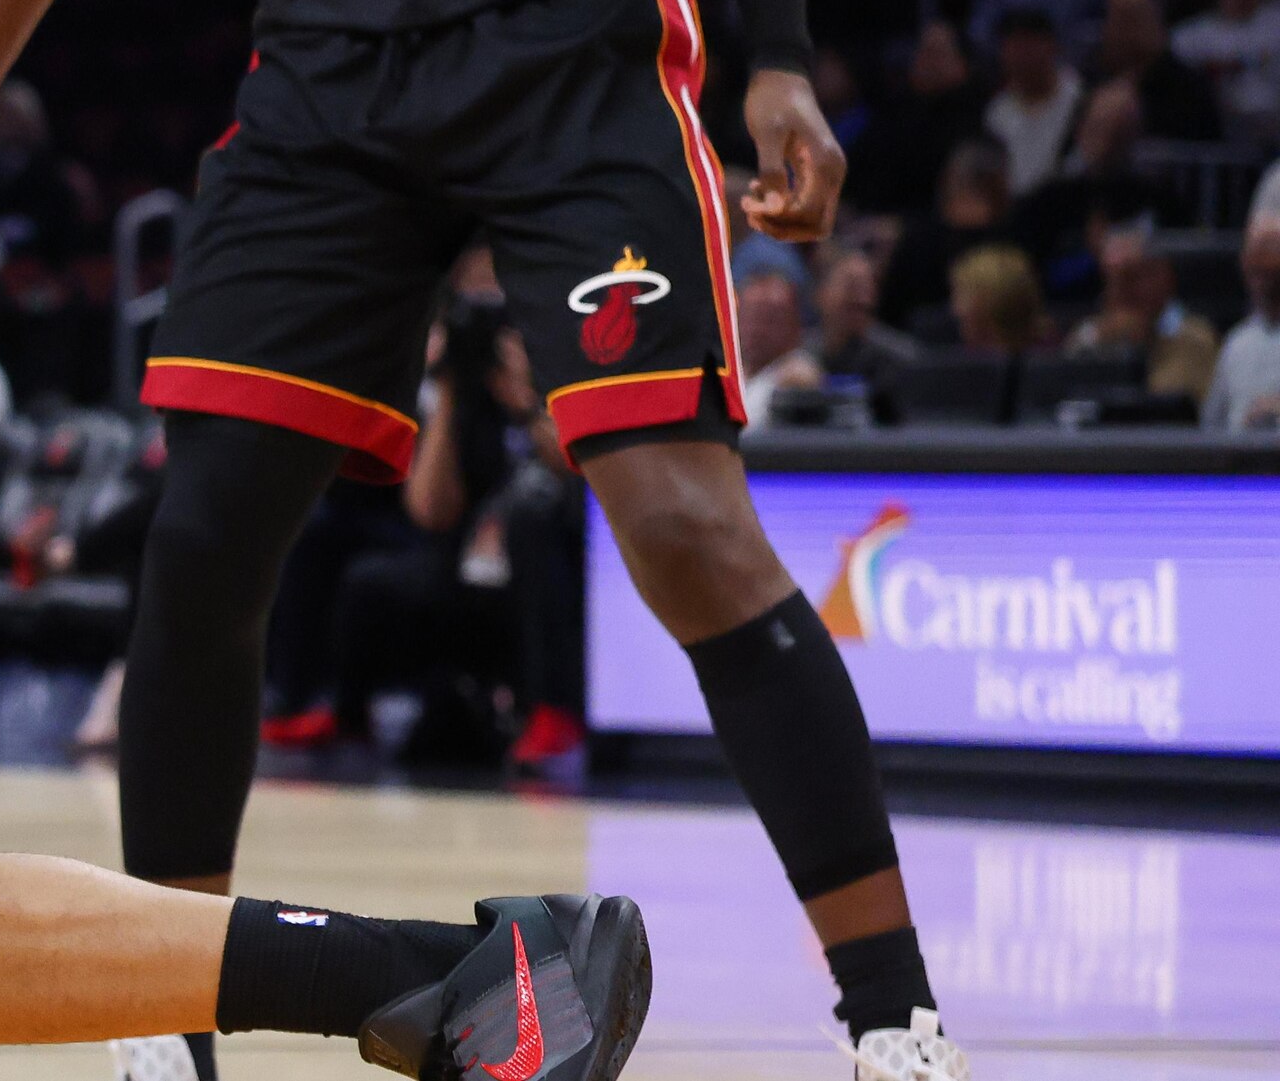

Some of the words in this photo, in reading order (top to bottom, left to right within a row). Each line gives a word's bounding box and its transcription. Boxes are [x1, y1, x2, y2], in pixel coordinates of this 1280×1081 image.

[882, 557, 1179, 653] Carnival
[975, 657, 1018, 719] is
[1020, 656, 1182, 743] calling
